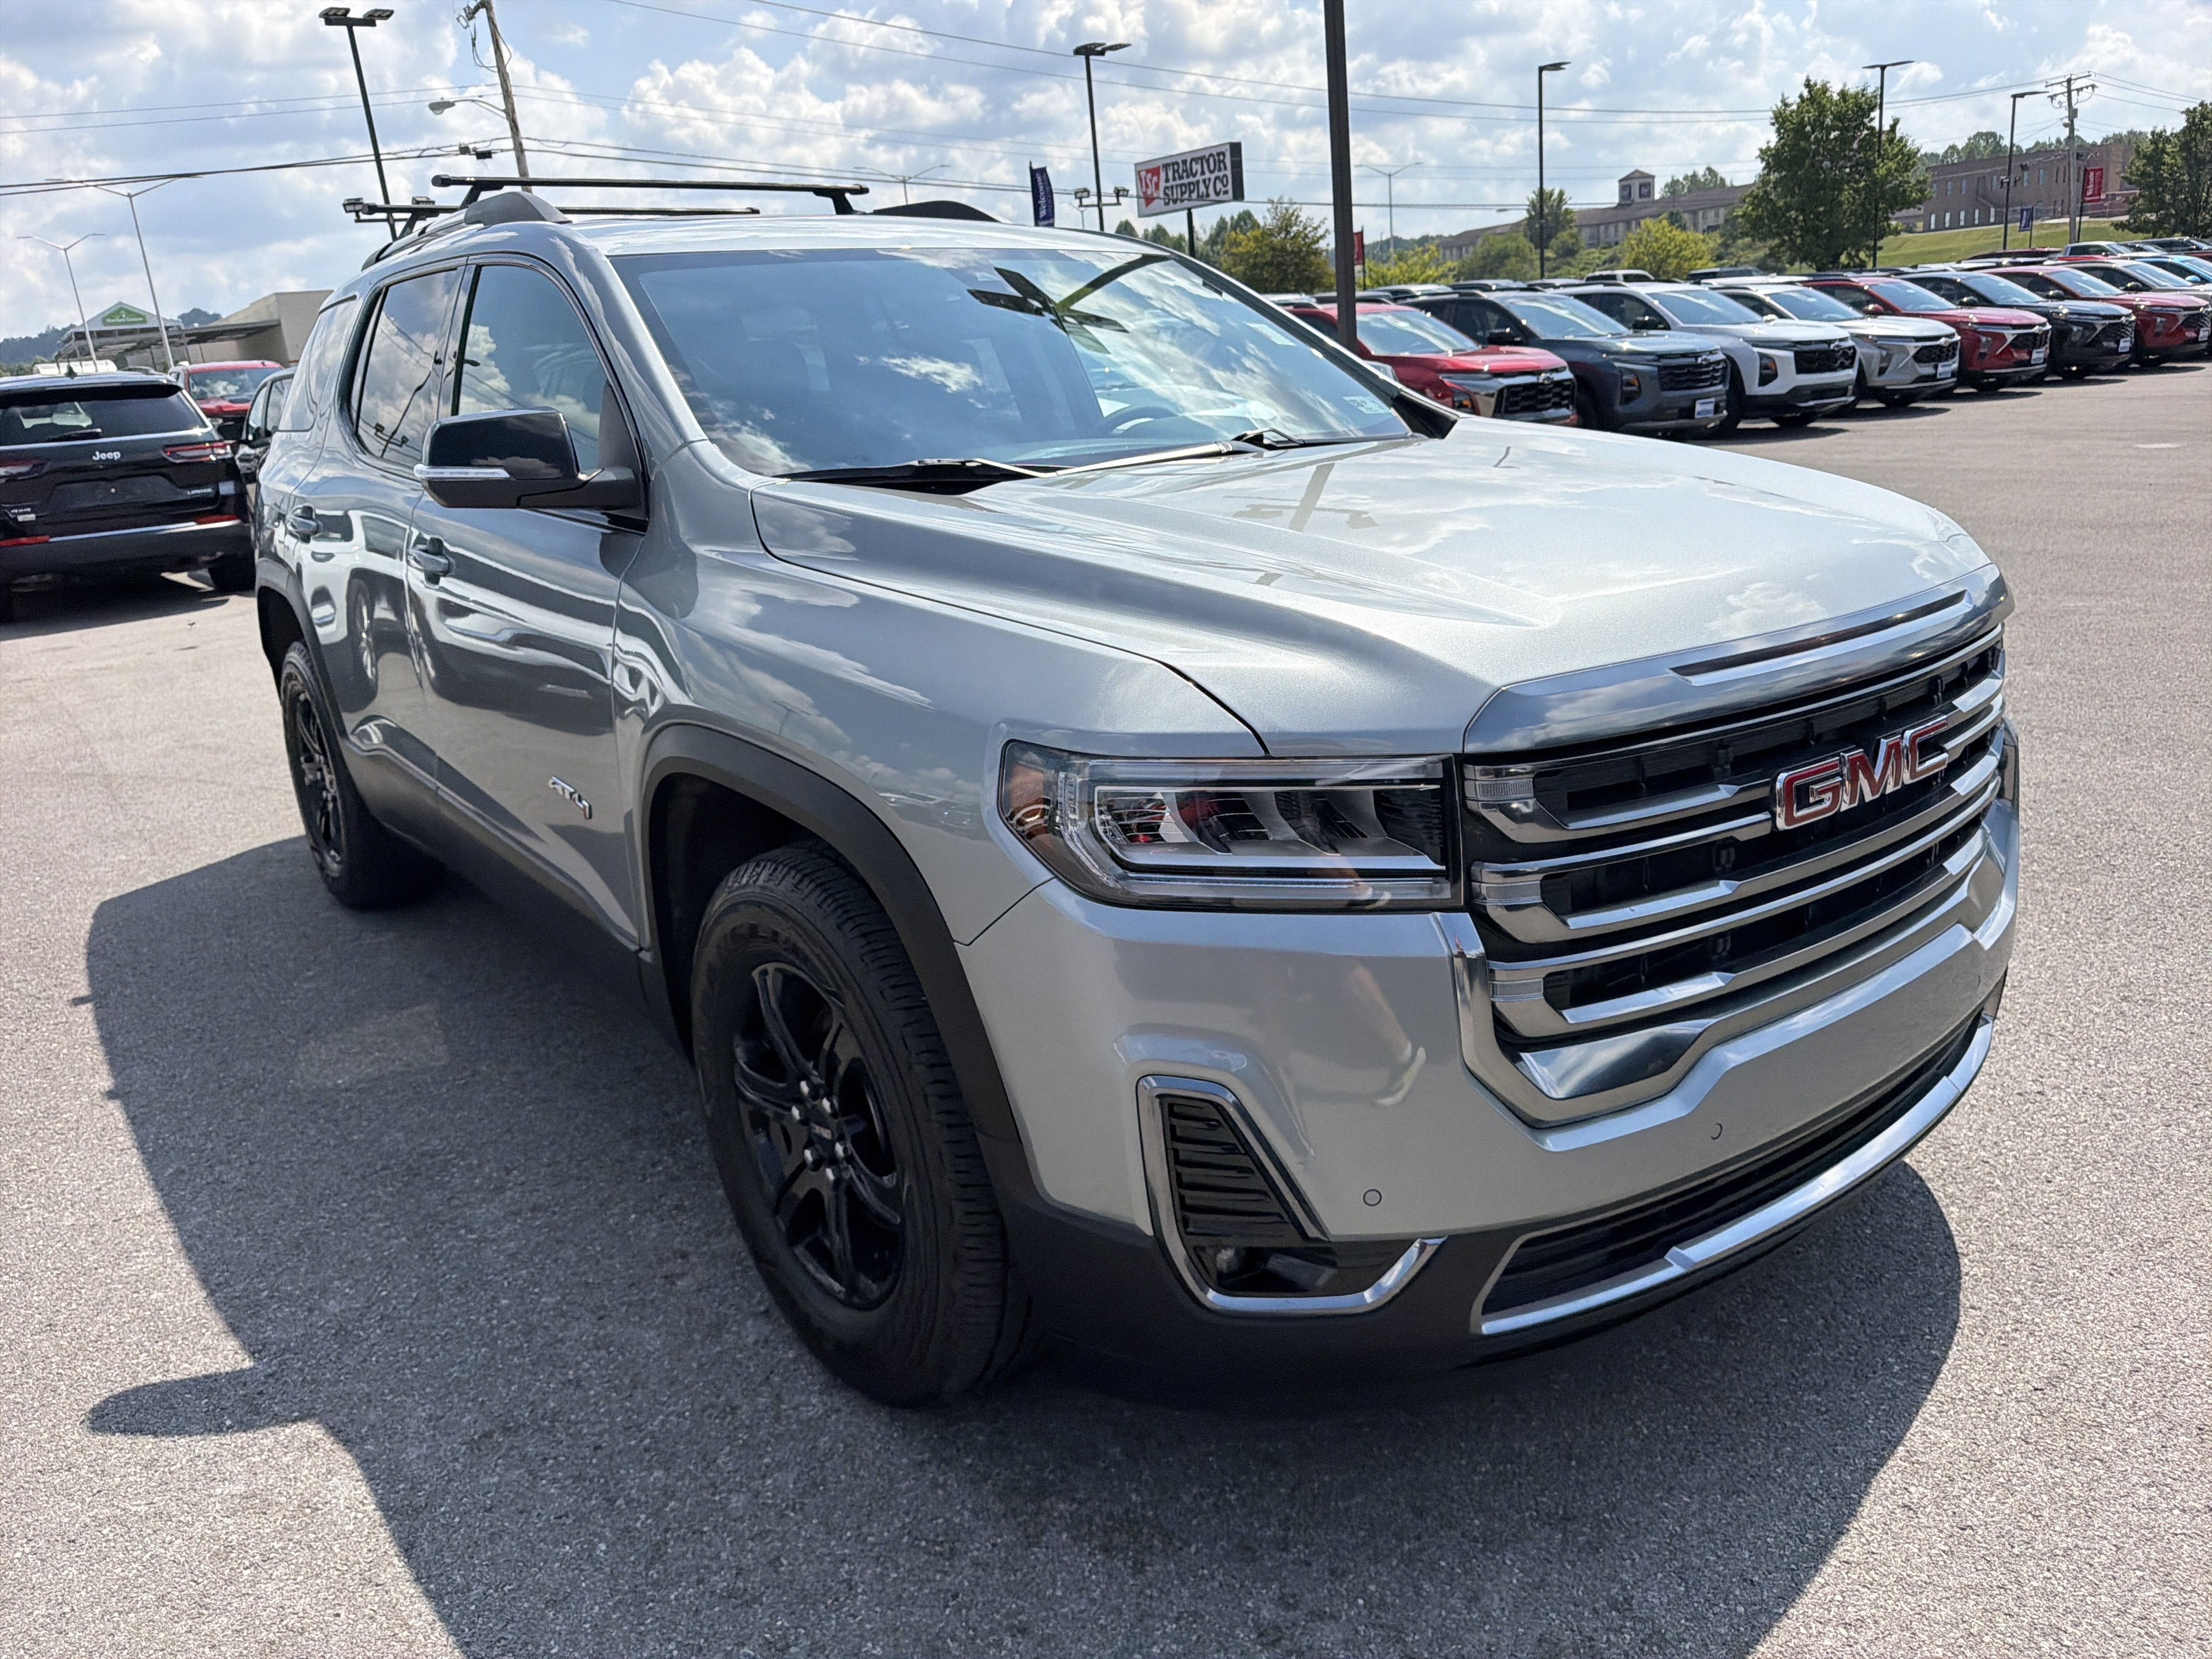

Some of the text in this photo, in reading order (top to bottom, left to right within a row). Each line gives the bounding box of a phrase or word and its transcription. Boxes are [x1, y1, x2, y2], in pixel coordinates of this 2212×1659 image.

[1162, 150, 1228, 184] TRACTOR
[1163, 177, 1212, 206] SUPPLY
[92, 451, 121, 461] Jeep
[1776, 715, 1949, 831] GMC
[549, 776, 592, 819] AT4
